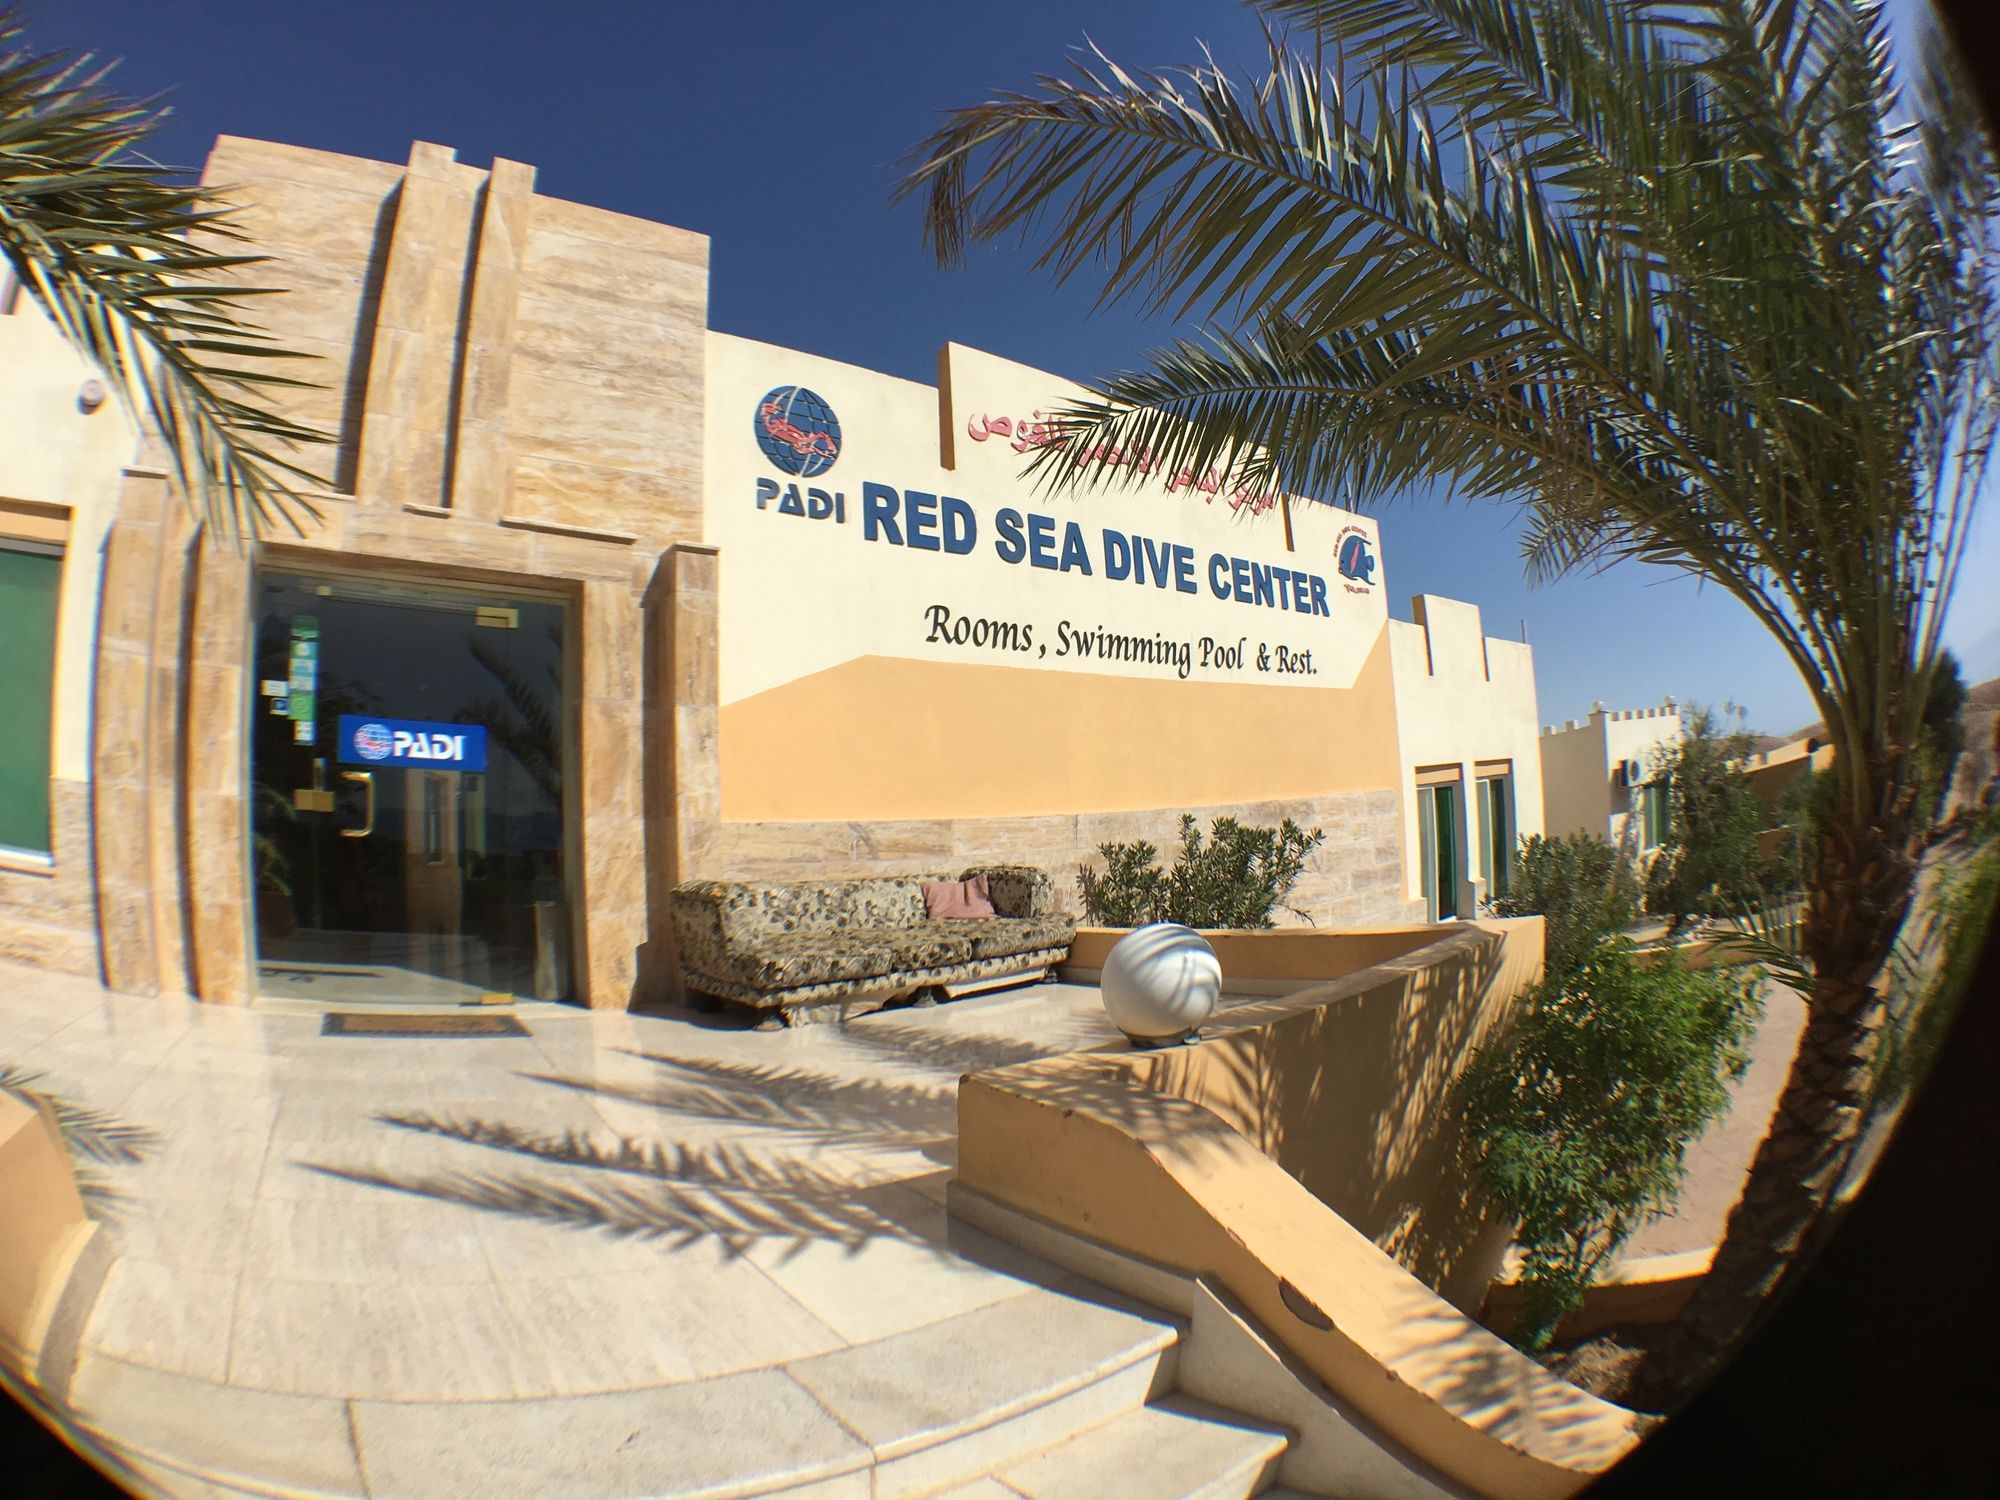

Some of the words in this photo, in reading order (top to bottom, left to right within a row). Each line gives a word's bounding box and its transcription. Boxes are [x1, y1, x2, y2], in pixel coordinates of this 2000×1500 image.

[756, 476, 847, 525] PADI
[862, 480, 978, 556] RED
[994, 506, 1094, 577] SEA
[1102, 528, 1198, 595] DIVE
[1208, 552, 1331, 618] CENTER
[1055, 619, 1191, 680] Swimming
[1197, 636, 1248, 670] Pool
[1256, 642, 1272, 673] &
[1275, 644, 1318, 675] Rest.
[391, 730, 468, 761] PADI
